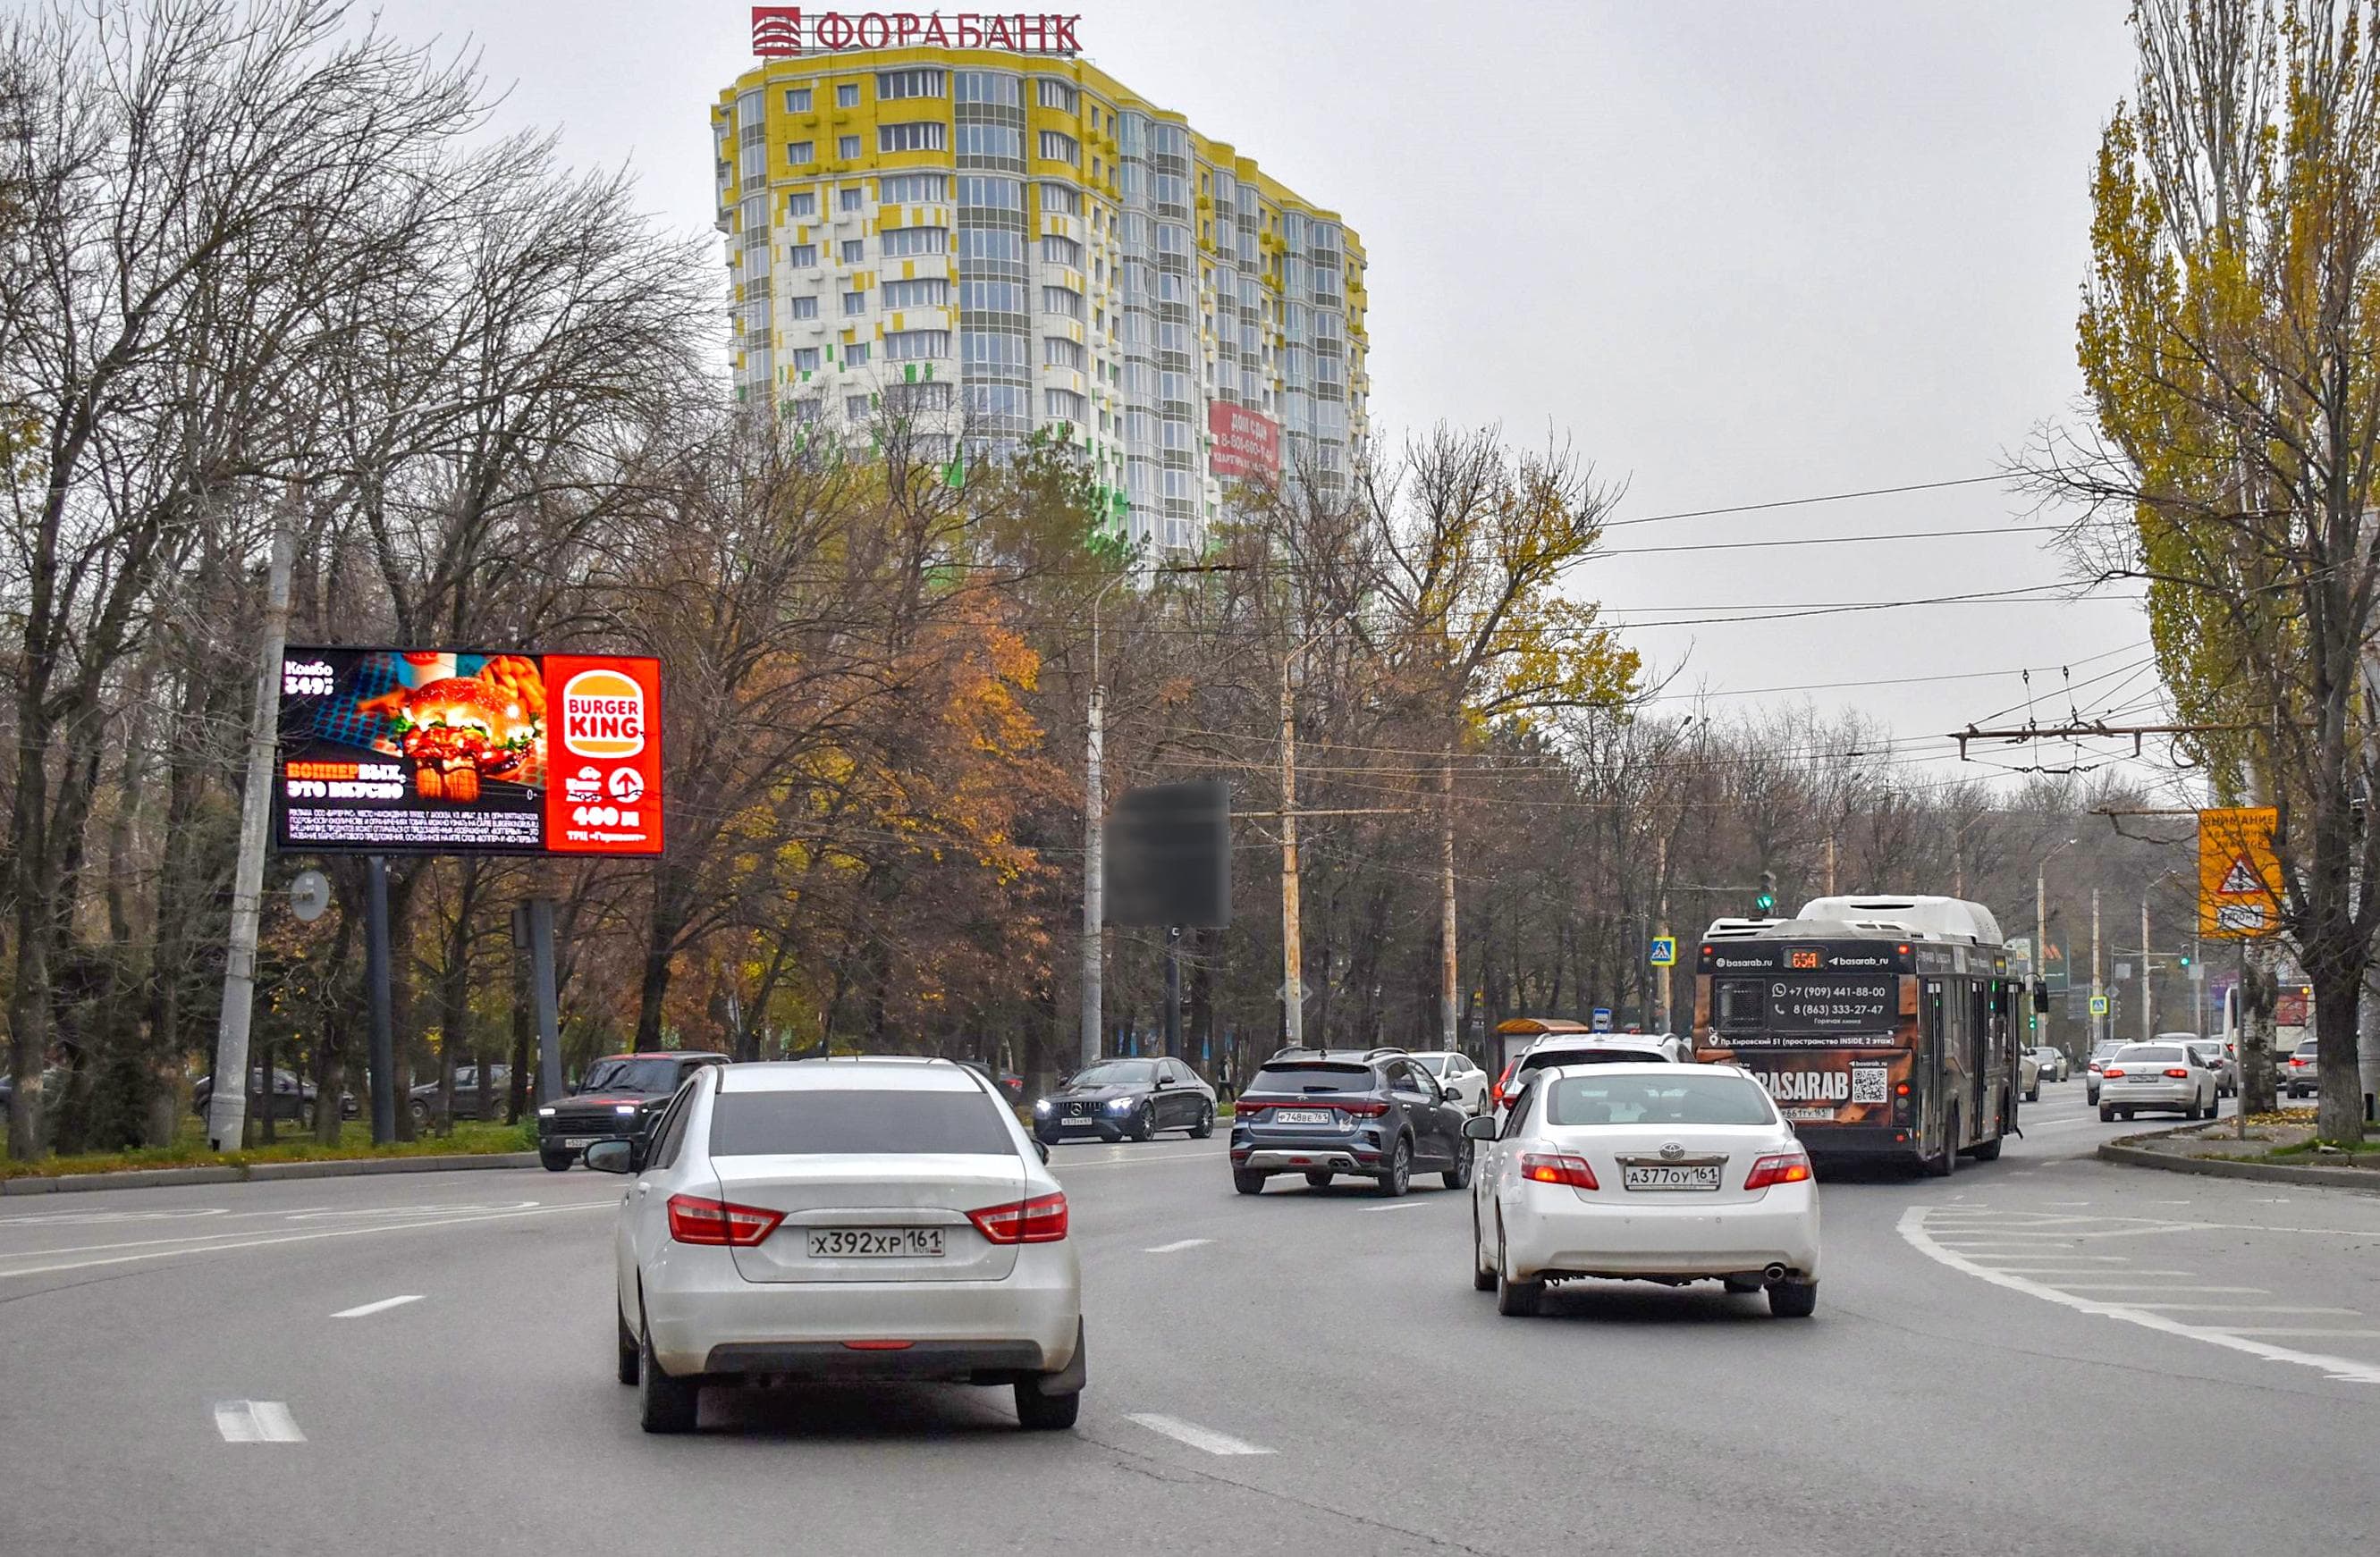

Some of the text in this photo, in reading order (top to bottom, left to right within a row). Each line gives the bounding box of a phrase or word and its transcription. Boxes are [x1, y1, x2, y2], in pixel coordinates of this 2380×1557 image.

[284, 661, 333, 676] Комбо
[569, 699, 638, 715] BURGER
[570, 716, 639, 738] KING
[287, 781, 326, 798] ЭТО
[572, 806, 619, 826] 400
[1726, 958, 1773, 967] basarab.ru
[1839, 956, 1889, 966] basarab_ru
[1789, 987, 1886, 999] +7 (909) 441-88-00
[1793, 1004, 1884, 1016] 8 (863) 333-27-47
[1630, 1167, 1716, 1183] А377ОУ 161
[814, 1230, 941, 1254] Х392ХР 161
